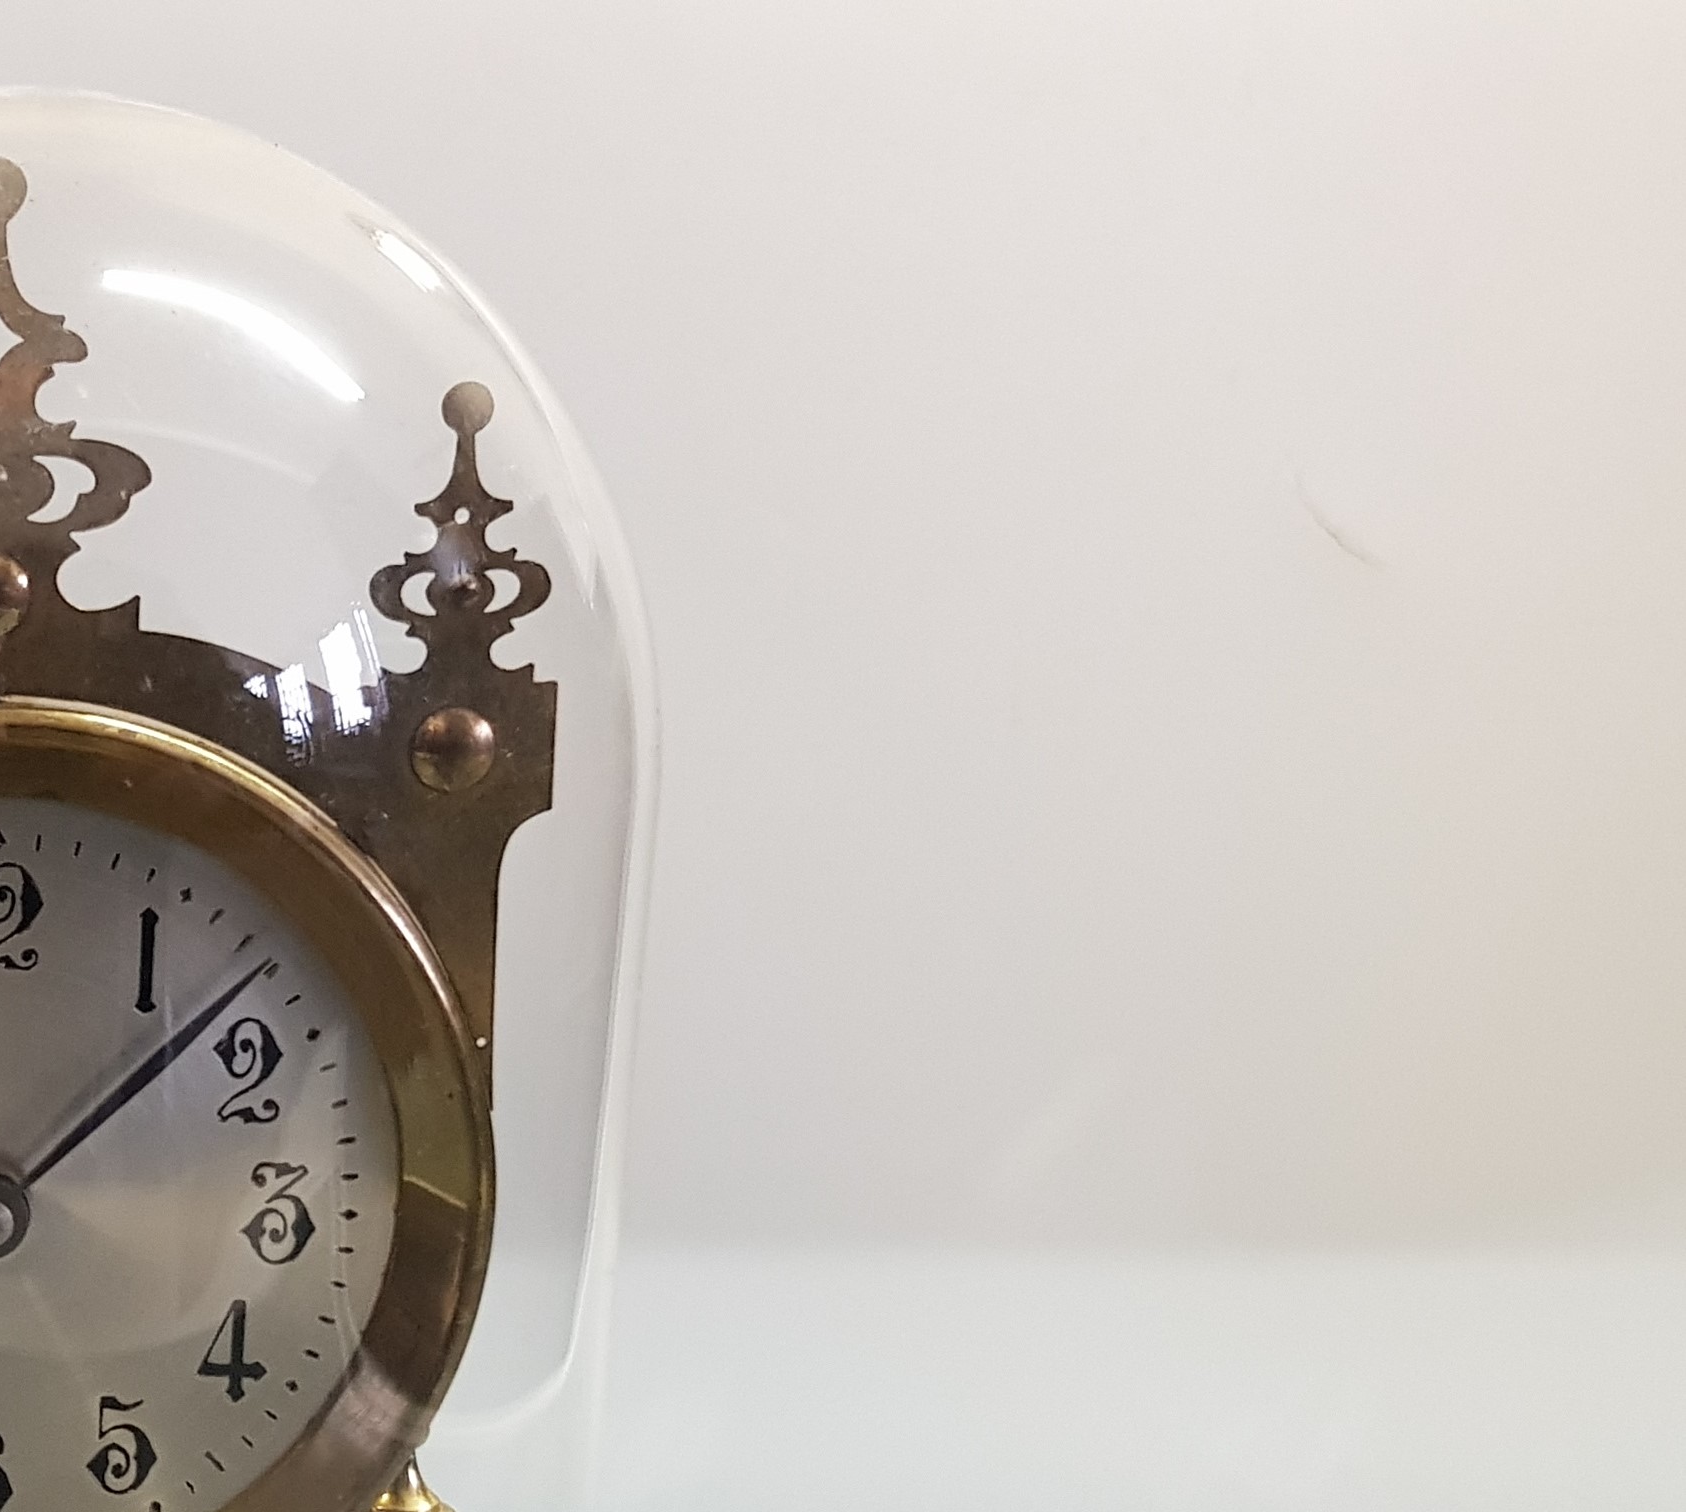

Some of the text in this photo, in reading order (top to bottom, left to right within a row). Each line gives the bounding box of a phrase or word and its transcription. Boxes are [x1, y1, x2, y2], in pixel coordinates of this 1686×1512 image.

[134, 906, 160, 1014] 1
[213, 1016, 285, 1124] 2
[241, 1161, 317, 1265] 3
[196, 1299, 268, 1403] 4
[85, 1395, 158, 1495] 5
